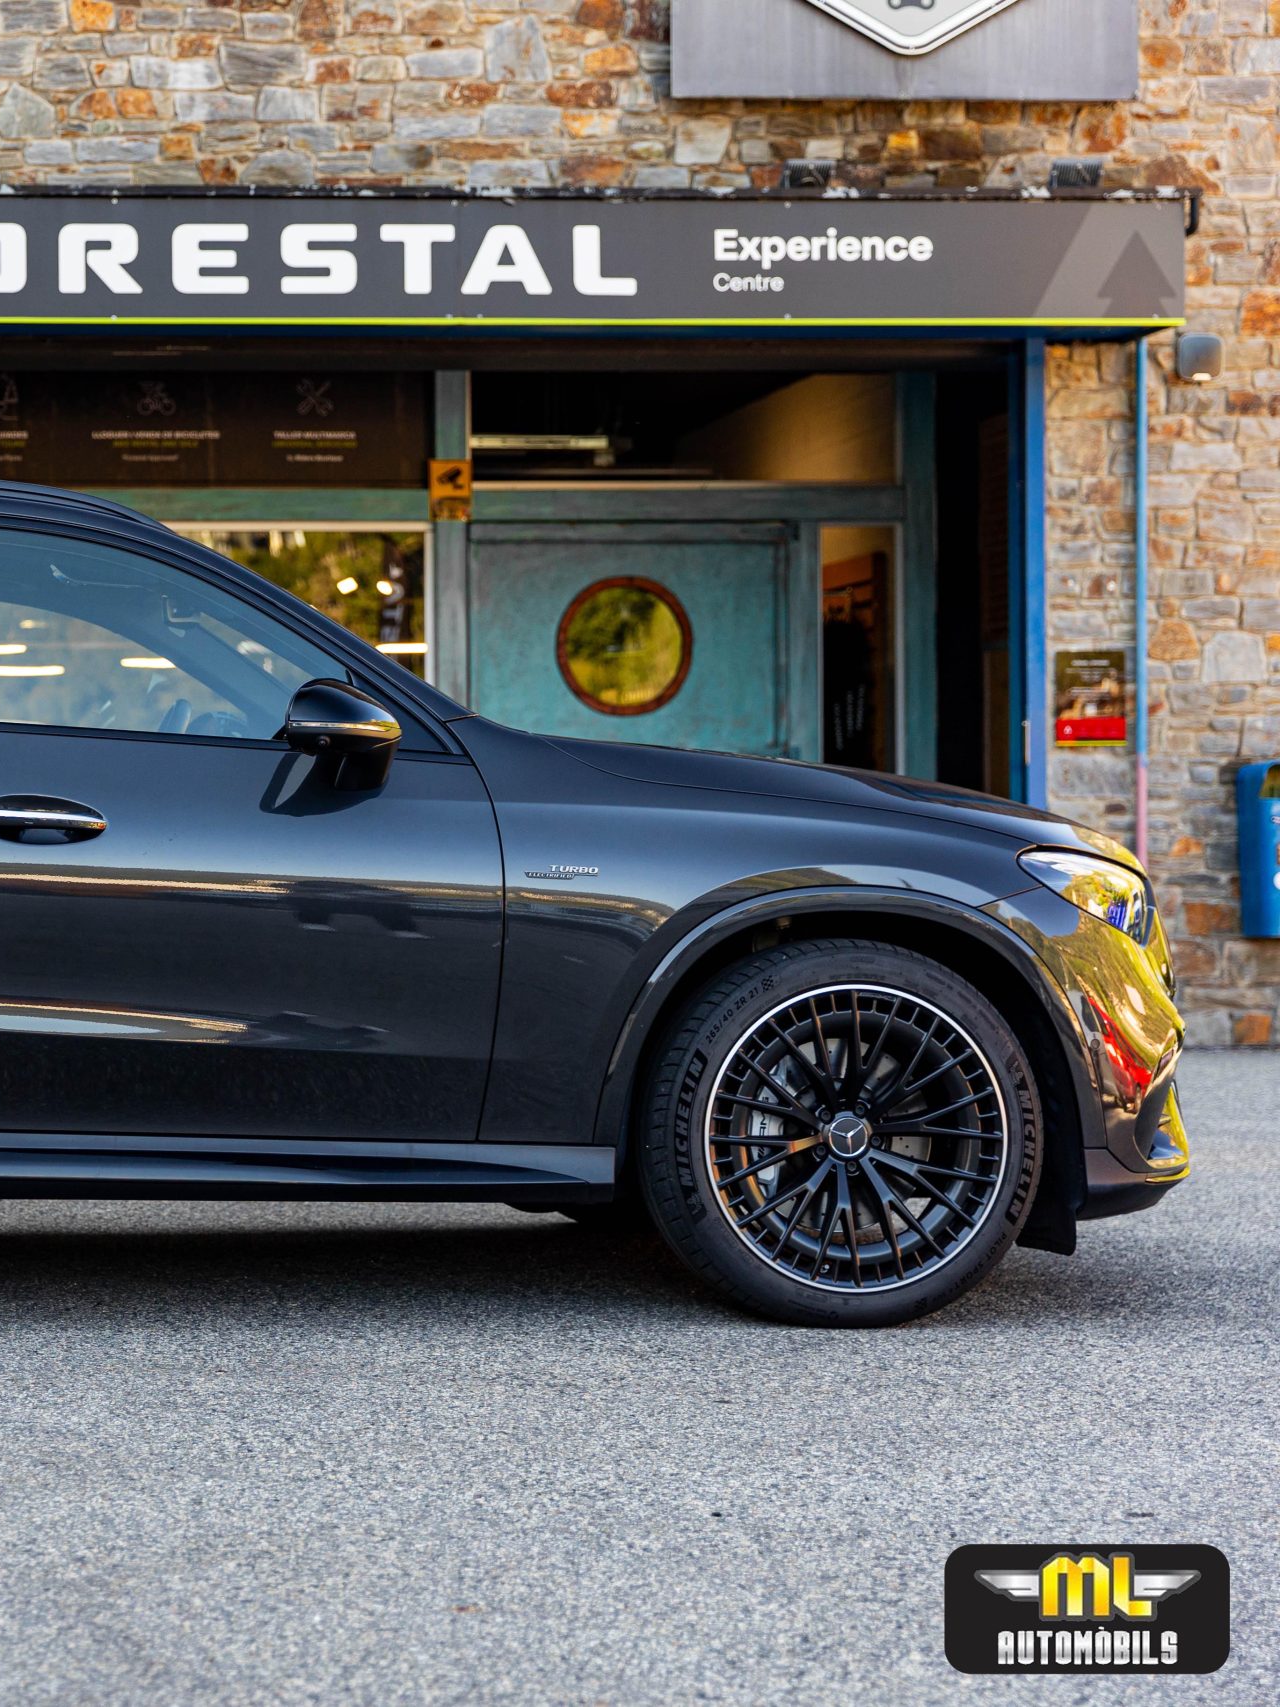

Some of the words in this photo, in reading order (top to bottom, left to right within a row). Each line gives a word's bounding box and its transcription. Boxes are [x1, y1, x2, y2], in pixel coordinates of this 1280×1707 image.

[714, 227, 933, 270] Experience
[713, 272, 784, 292] Centre
[549, 864, 599, 874] TURBO
[734, 996, 748, 1010] ZR
[748, 987, 759, 999] 21
[675, 1056, 704, 1188] MICHELIN
[1009, 1089, 1037, 1219] MICHELIN
[986, 1231, 1007, 1260] PILOT
